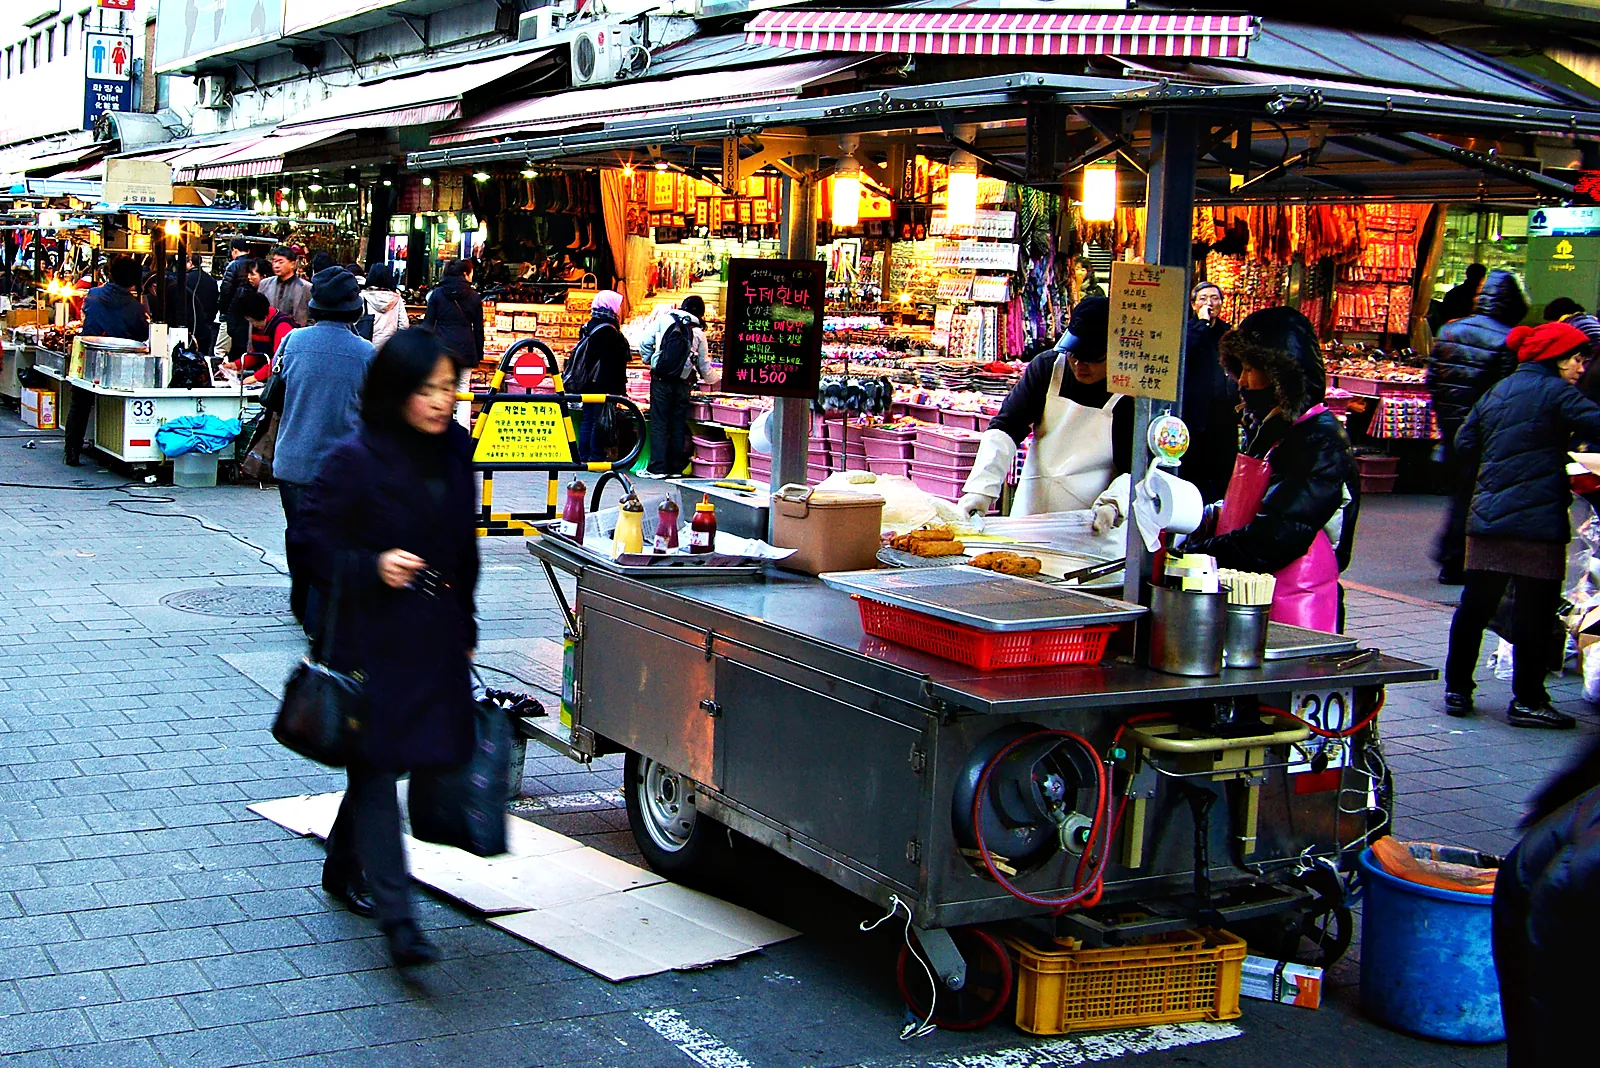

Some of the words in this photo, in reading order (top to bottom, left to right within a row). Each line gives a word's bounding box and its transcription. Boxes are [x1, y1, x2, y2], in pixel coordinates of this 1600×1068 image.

[92, 84, 123, 93] 화장실
[96, 93, 119, 102] Toilet
[133, 400, 153, 416] 33
[505, 406, 526, 415] 차없는
[533, 406, 546, 415] 거리
[1301, 692, 1345, 741] 30
